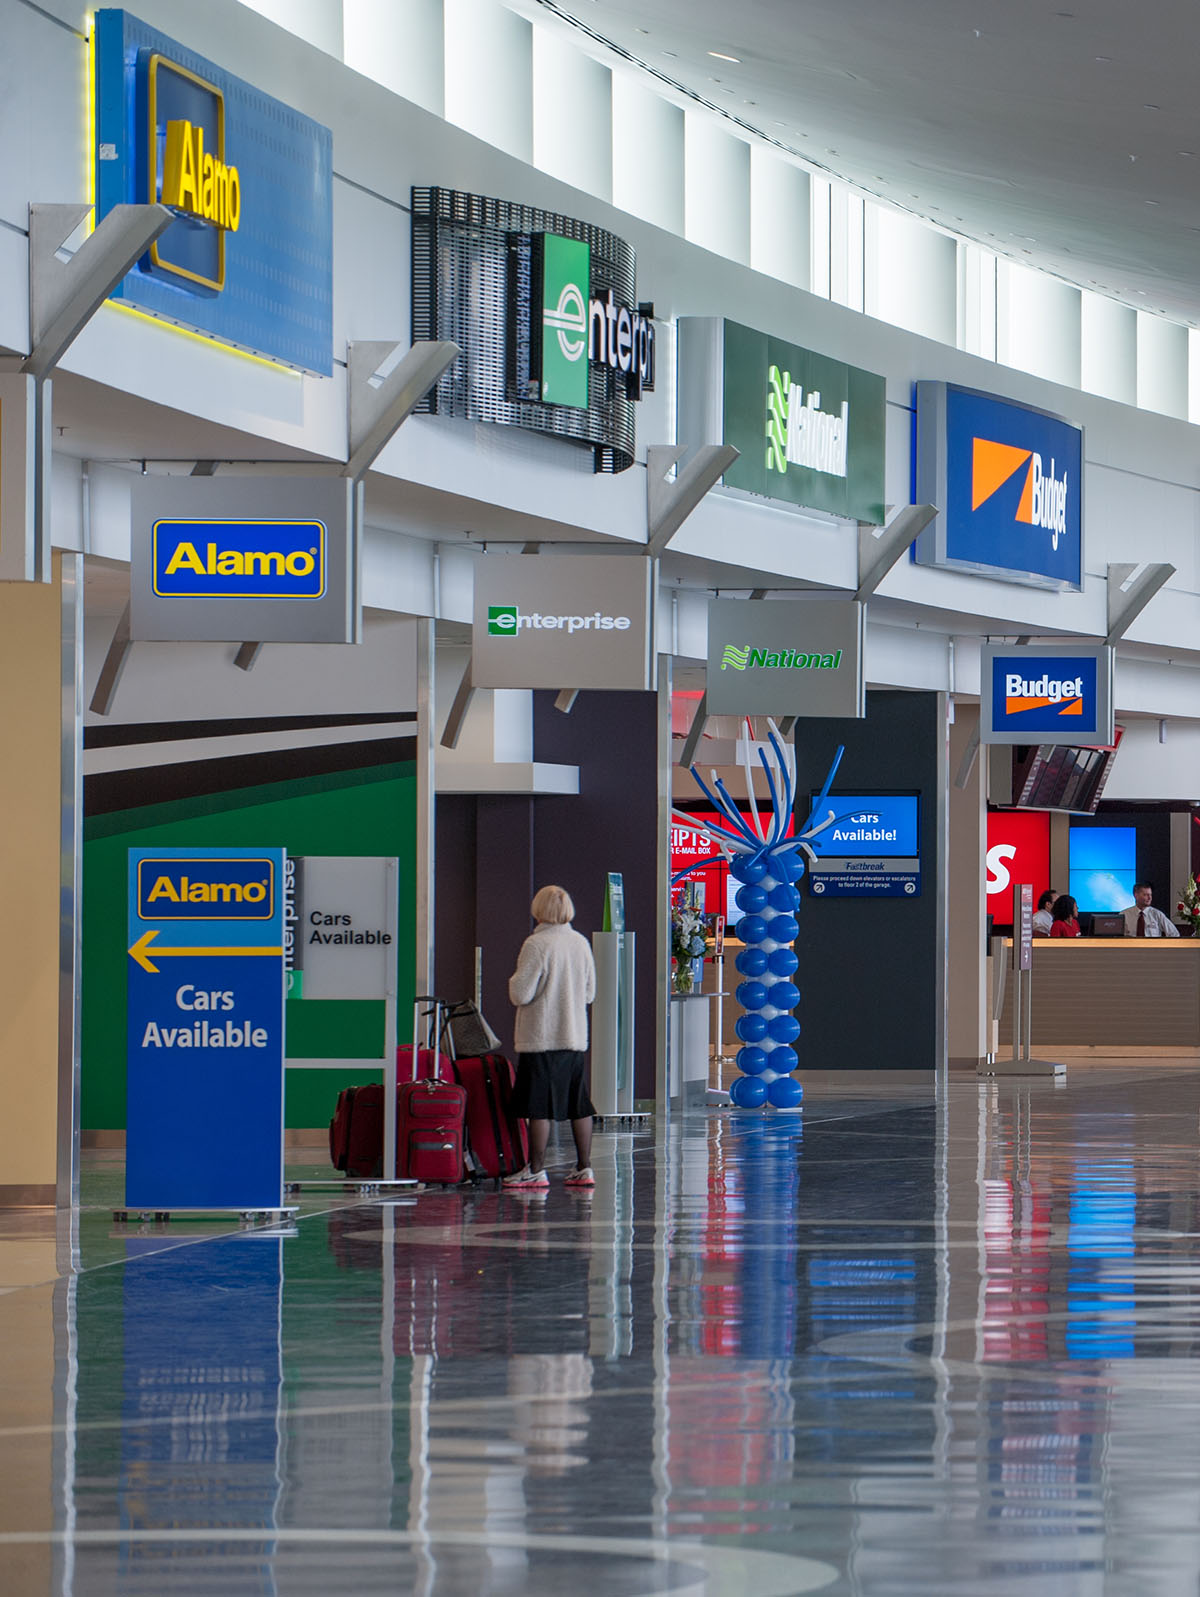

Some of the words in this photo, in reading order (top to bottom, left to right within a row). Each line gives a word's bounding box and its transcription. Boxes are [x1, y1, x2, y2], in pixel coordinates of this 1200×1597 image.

[177, 119, 240, 232] Alamo
[785, 381, 848, 478] National
[1032, 451, 1068, 551] Budget
[164, 541, 316, 577] Alamo
[488, 611, 631, 634] enterprise
[748, 647, 842, 669] National
[1005, 674, 1083, 703] Budget
[832, 829, 897, 841] Available!
[675, 847, 697, 855] E-MAIL
[698, 847, 711, 855] BOX
[846, 862, 885, 871] Fastbreak
[147, 876, 266, 903] Alamo
[309, 911, 352, 926] Cars
[309, 930, 392, 945] Available
[176, 984, 235, 1011] Cars
[141, 1021, 268, 1048] Available
